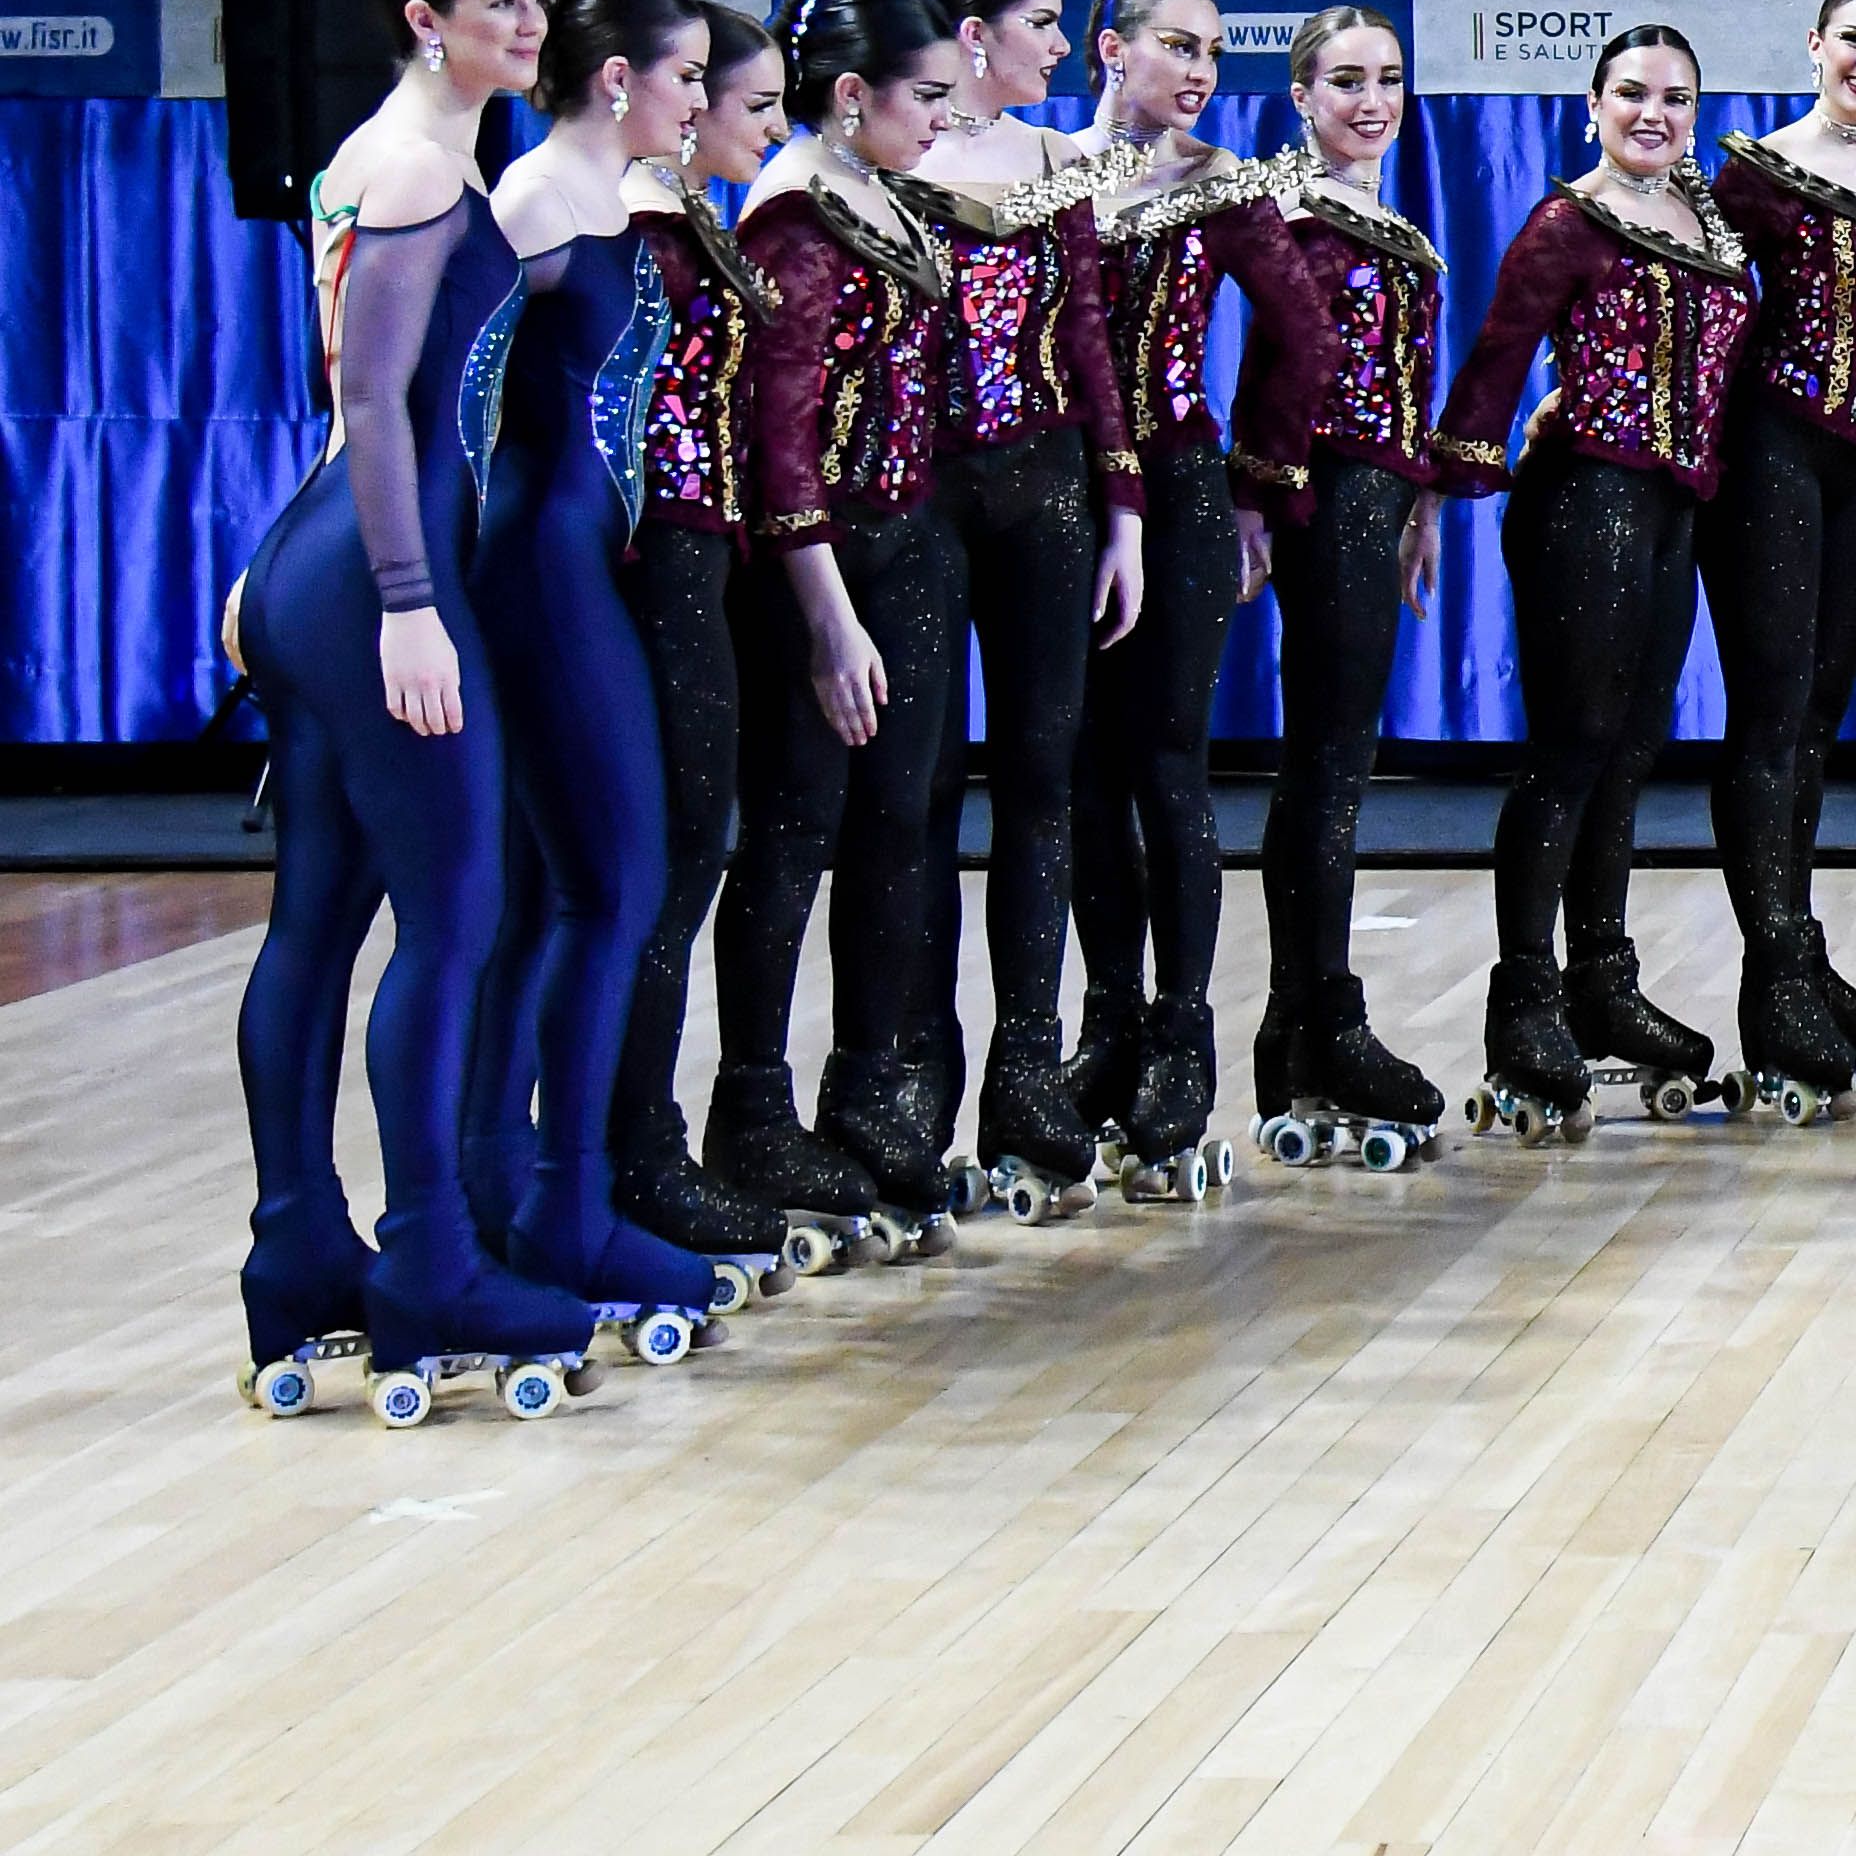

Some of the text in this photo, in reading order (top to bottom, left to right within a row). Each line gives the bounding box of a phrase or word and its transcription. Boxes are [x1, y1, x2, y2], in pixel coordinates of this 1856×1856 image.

[0, 21, 97, 50] w.fisr.it
[1495, 11, 1613, 38] SPORT
[1495, 44, 1507, 60] E
